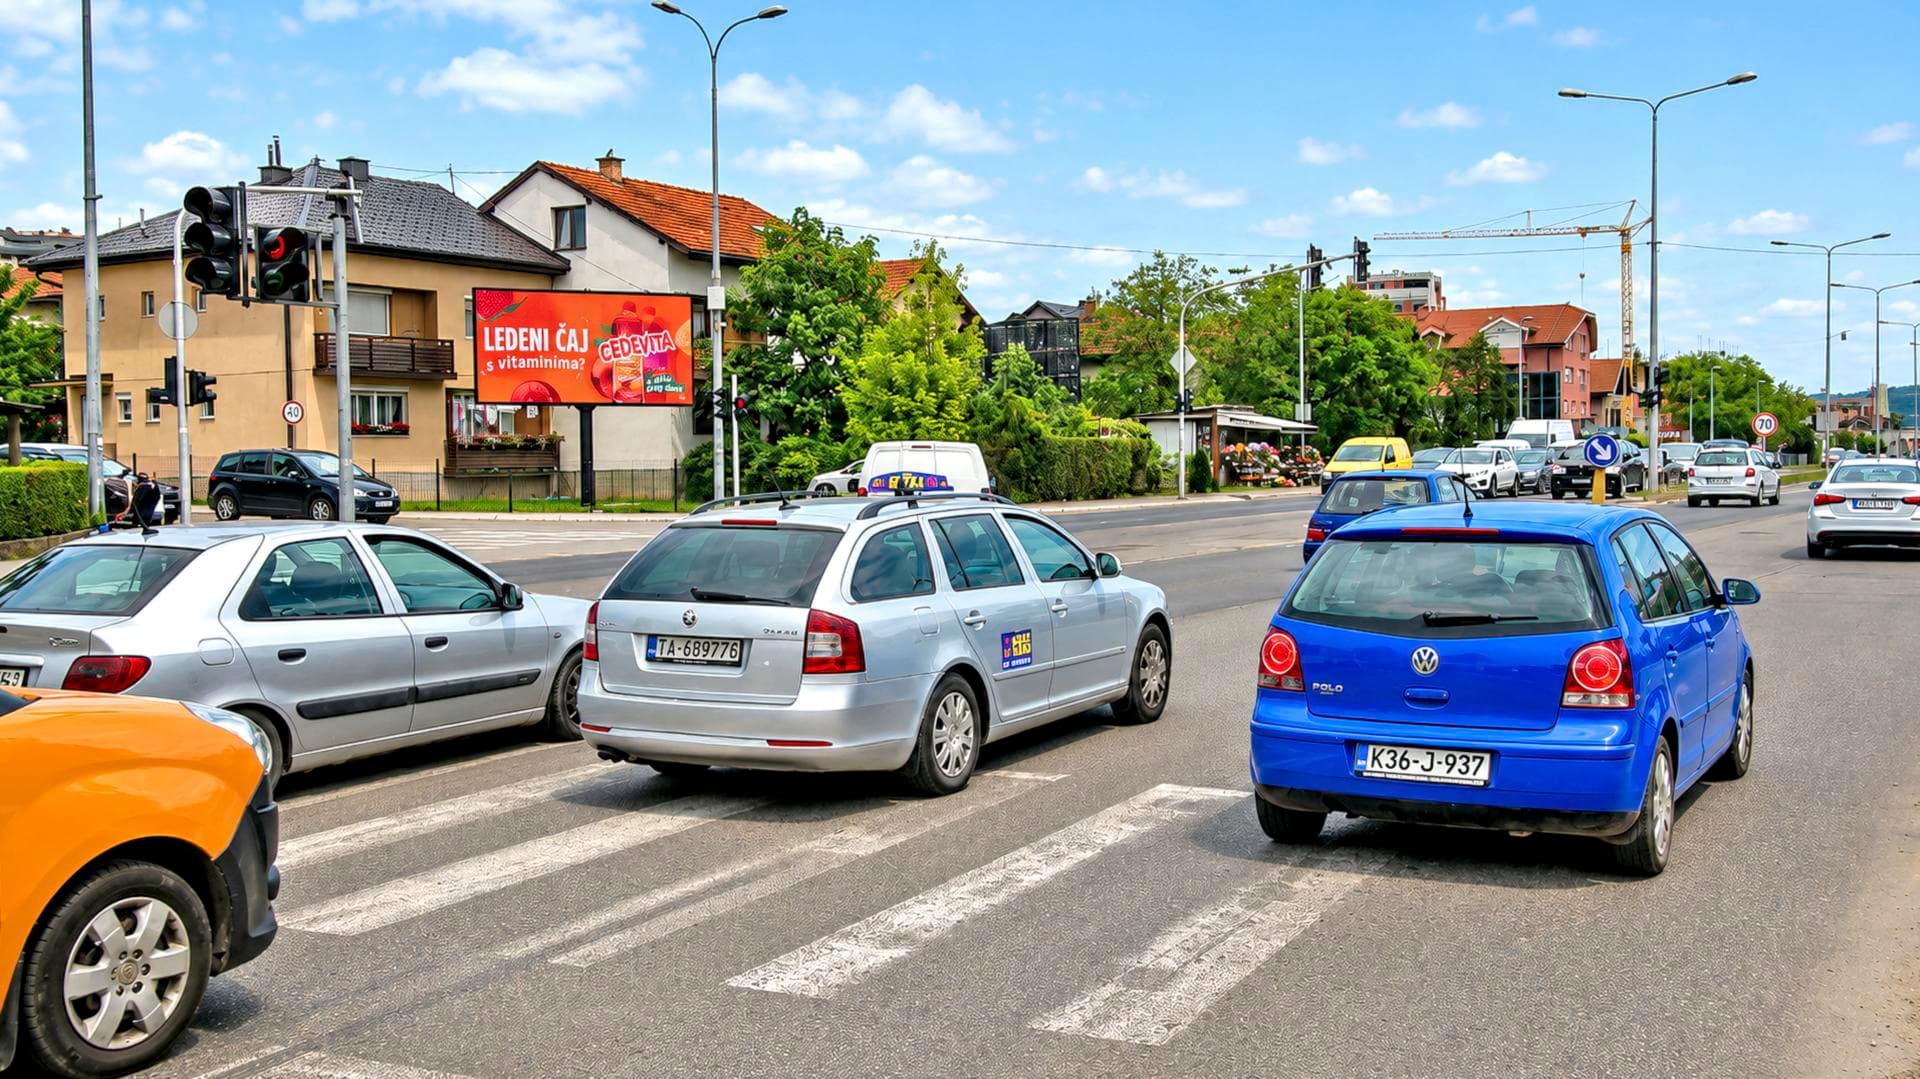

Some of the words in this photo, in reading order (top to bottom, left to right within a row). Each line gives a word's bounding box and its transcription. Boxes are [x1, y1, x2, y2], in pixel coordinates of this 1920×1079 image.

[484, 327, 549, 352] LEDENI
[556, 322, 589, 353] ČAJ
[600, 331, 676, 362] CEDEVITA
[486, 361, 494, 372] s
[498, 355, 585, 370] vitaminima?
[1758, 418, 1773, 430] 70
[658, 638, 739, 659] TA-689776
[1312, 682, 1344, 693] POLO
[1370, 747, 1485, 776] K36-J-937
